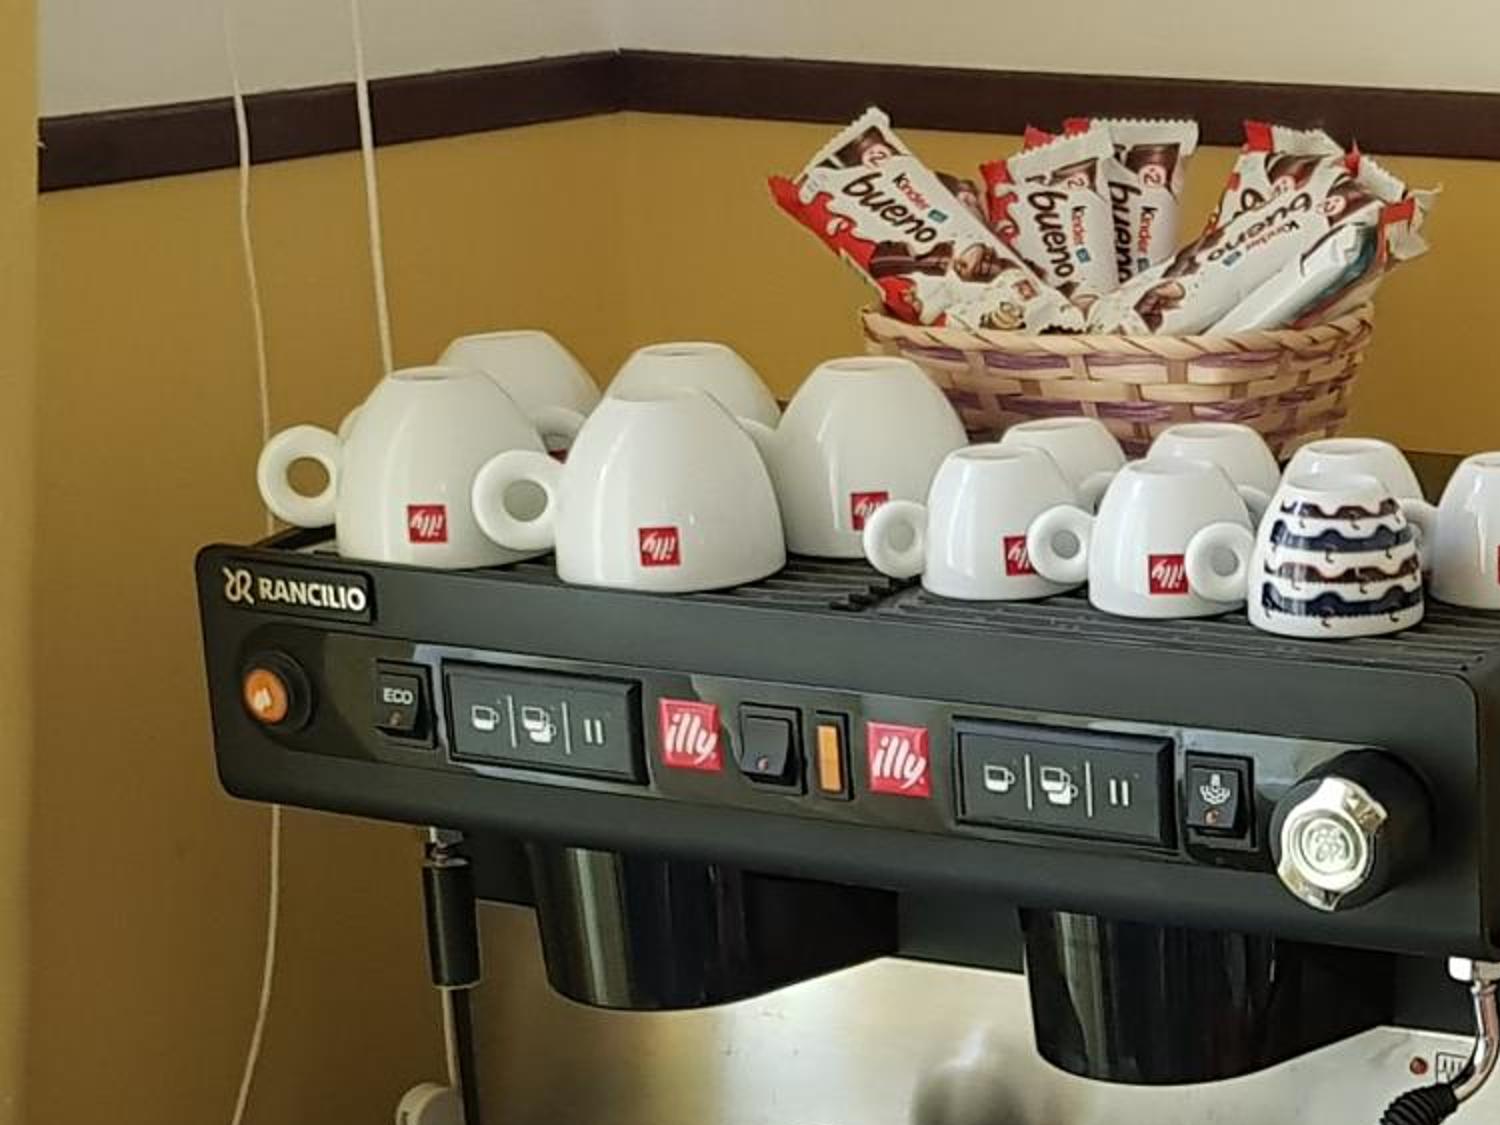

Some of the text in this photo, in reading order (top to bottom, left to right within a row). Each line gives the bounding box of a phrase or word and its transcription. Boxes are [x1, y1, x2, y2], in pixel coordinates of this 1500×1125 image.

[842, 171, 938, 243] bueno
[1107, 180, 1142, 284] bueno
[1207, 192, 1312, 261] bueno
[1027, 191, 1075, 278] bueno
[410, 508, 444, 538] illy
[641, 530, 676, 561] illy
[258, 577, 367, 612] RANCILIO
[1151, 558, 1186, 589] illy
[383, 687, 414, 705] ECO
[664, 712, 718, 765] illy
[871, 735, 926, 790] illy
